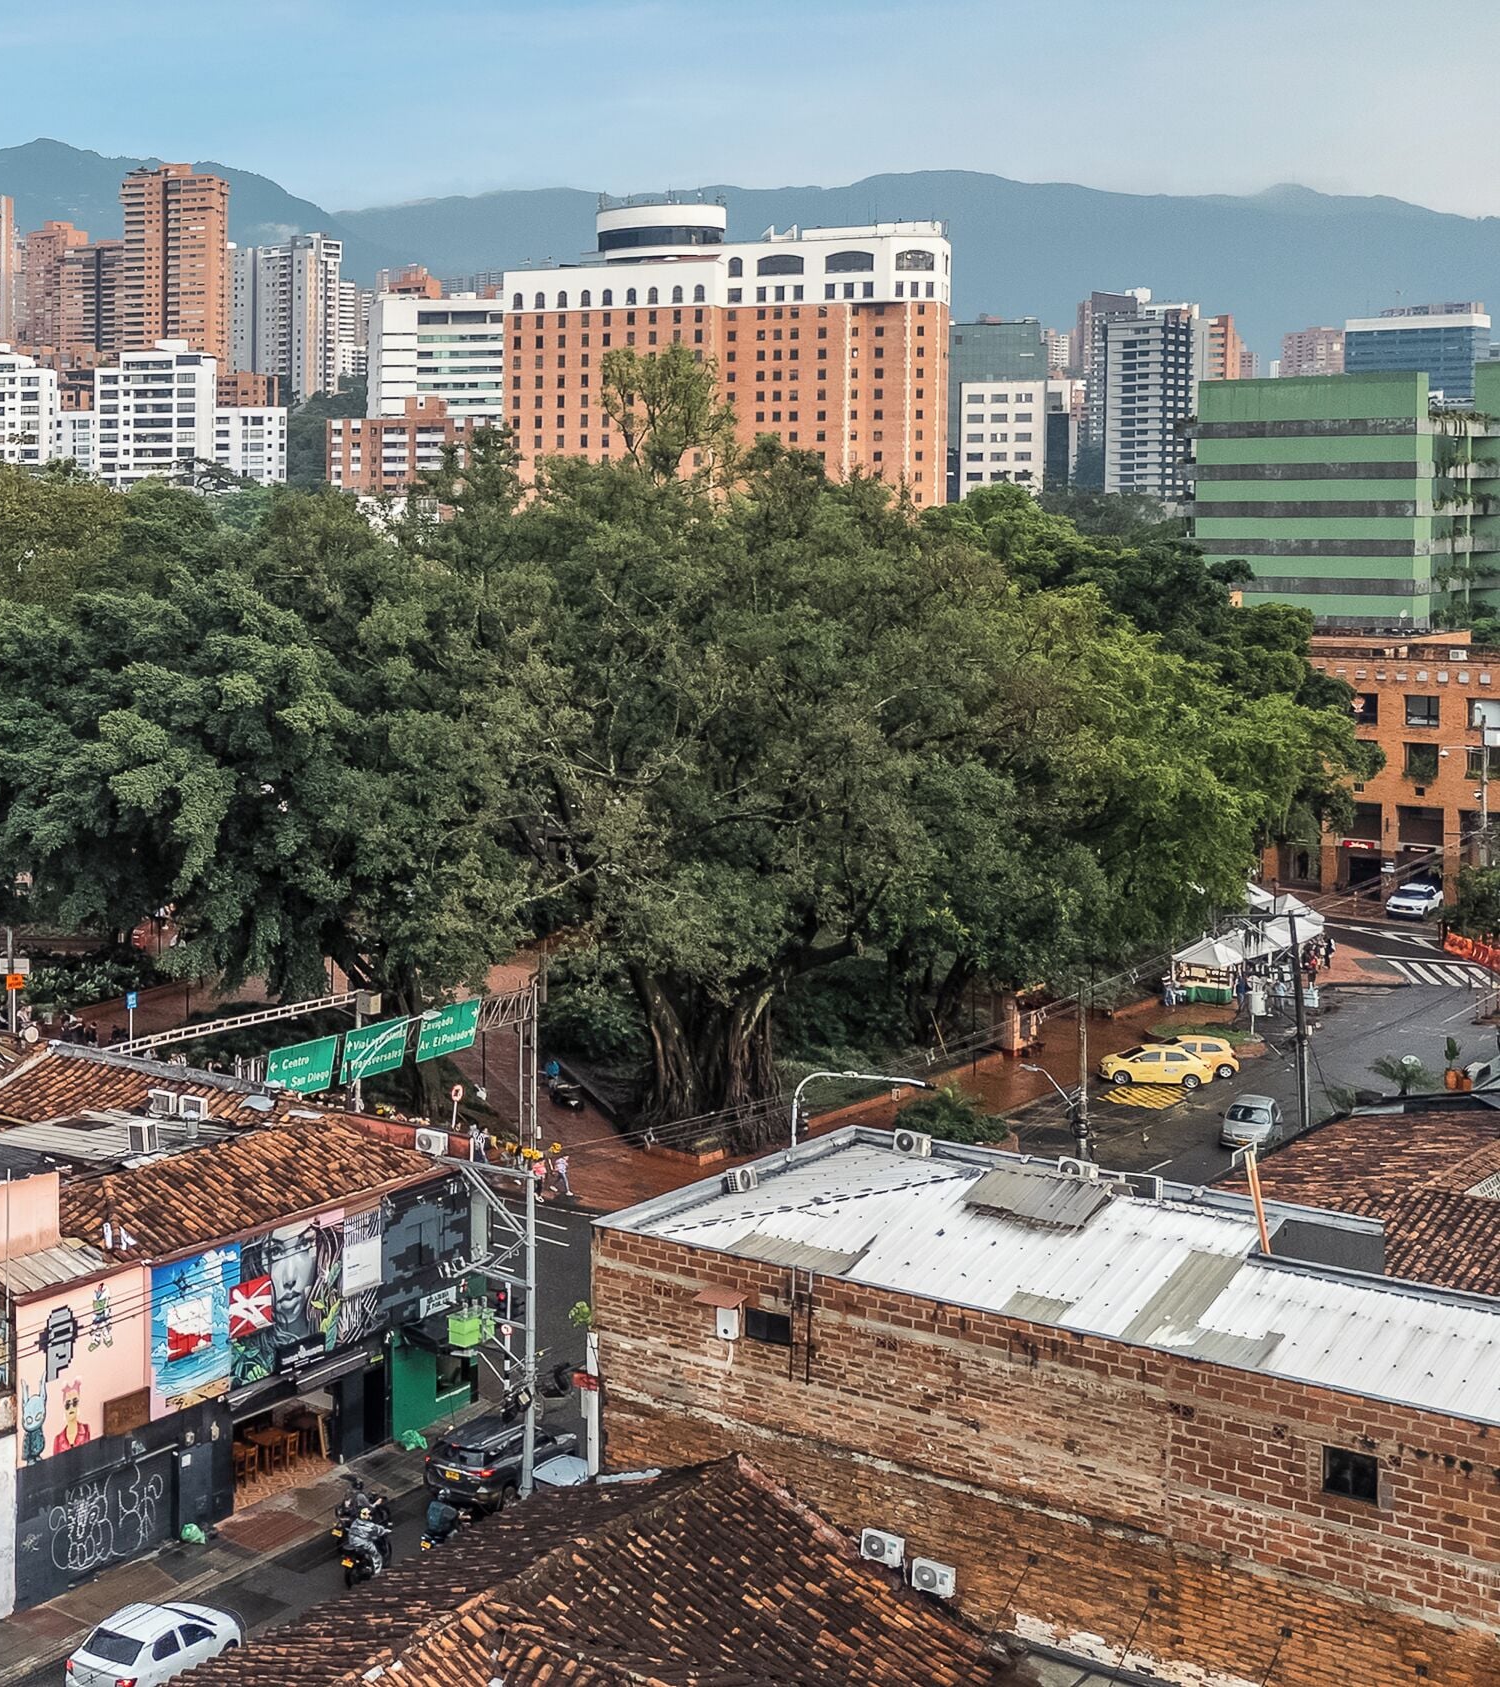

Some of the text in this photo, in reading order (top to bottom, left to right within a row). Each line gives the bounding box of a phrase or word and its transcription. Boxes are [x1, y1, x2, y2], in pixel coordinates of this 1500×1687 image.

[421, 1016, 454, 1032] Envigado
[419, 1030, 468, 1050] Av. El Poblado
[281, 1056, 310, 1070] Centro
[290, 1070, 330, 1088] San Diego
